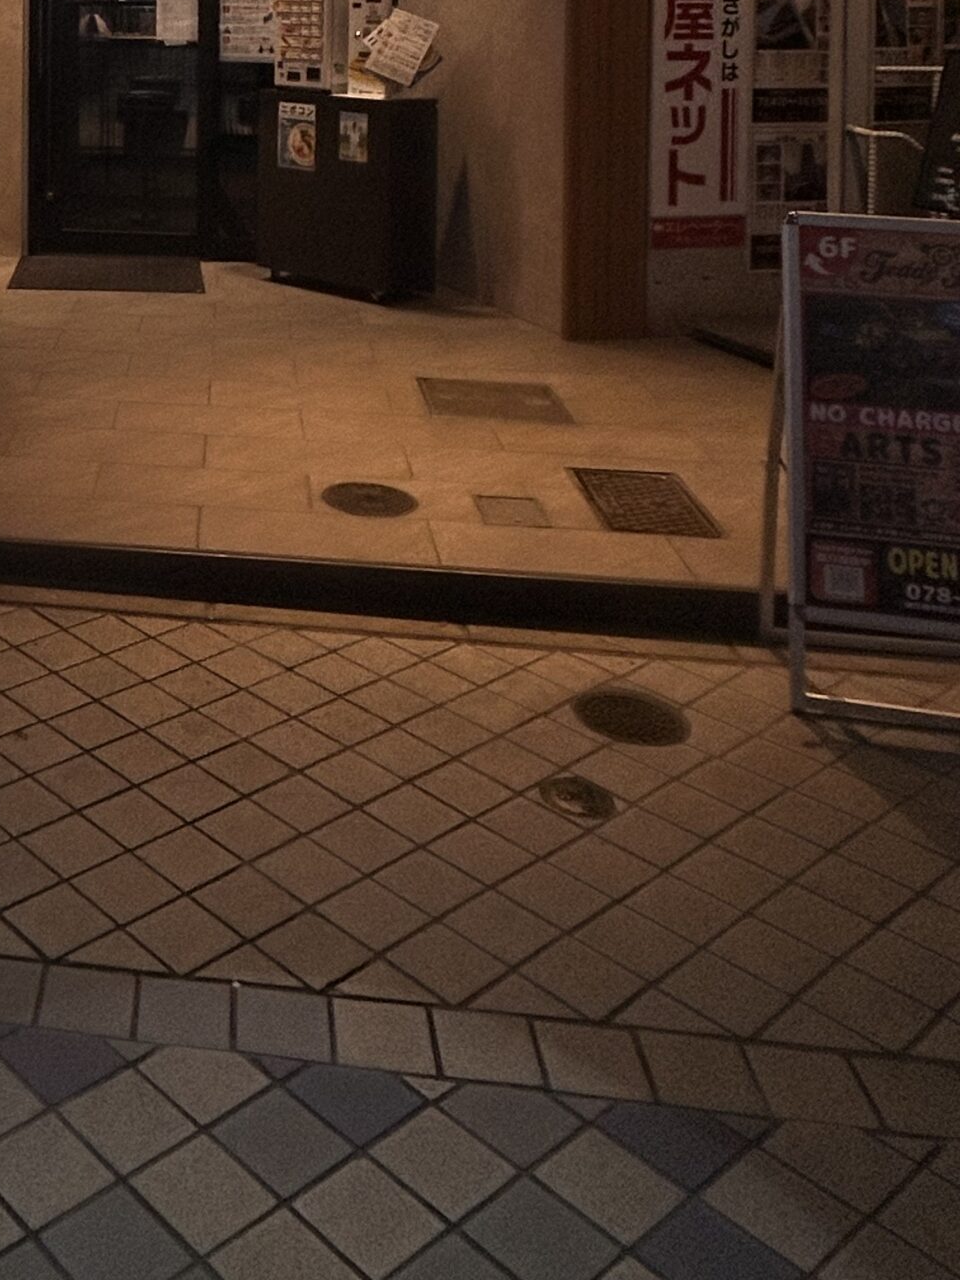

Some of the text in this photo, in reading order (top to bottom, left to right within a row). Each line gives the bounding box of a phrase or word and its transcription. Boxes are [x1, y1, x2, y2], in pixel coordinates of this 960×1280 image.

[818, 236, 857, 258] 6F
[809, 402, 847, 423] NO
[887, 547, 958, 581] OPEN
